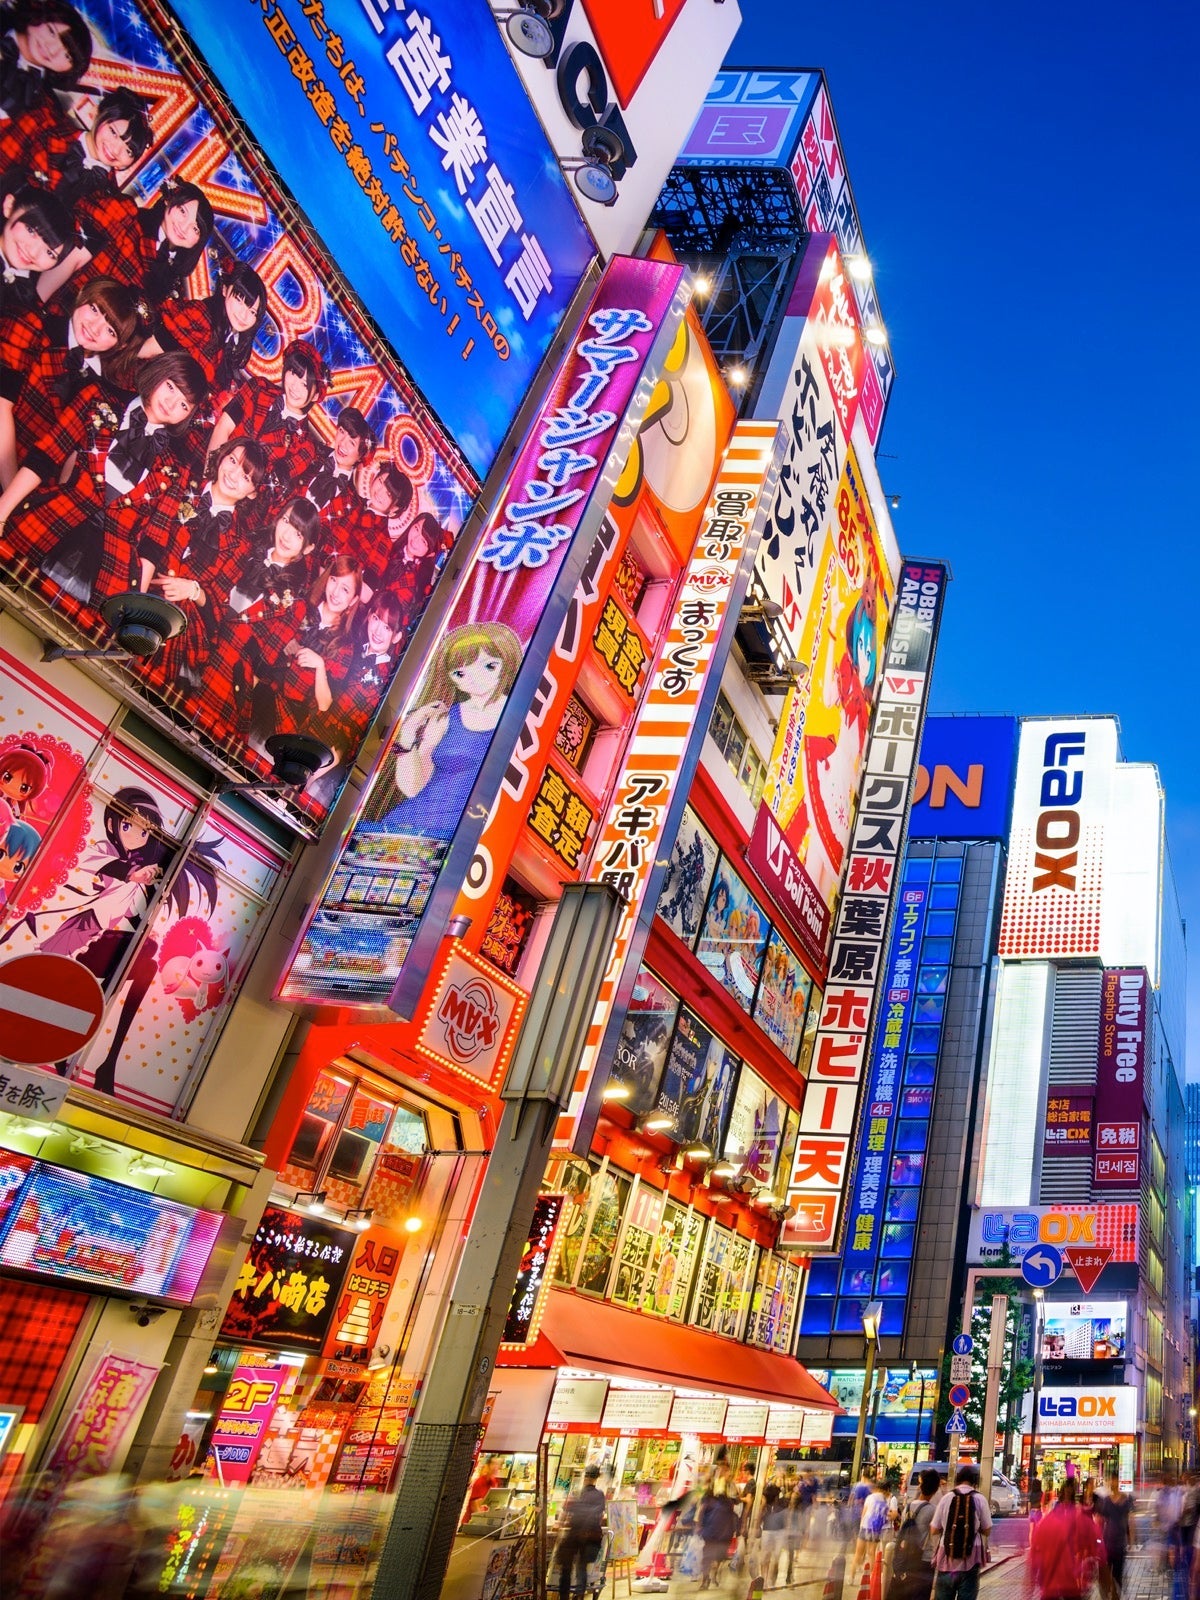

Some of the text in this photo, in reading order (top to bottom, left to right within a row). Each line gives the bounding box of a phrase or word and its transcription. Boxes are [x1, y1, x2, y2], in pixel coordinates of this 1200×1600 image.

[479, 307, 655, 572] サマージャンボ
[702, 489, 754, 561] 買取り
[889, 566, 924, 666] PARADISE
[917, 568, 942, 634] HOBBY
[661, 599, 723, 696] まっくす
[545, 765, 592, 841] 高額
[529, 797, 584, 867] 査定
[905, 892, 923, 902] 6F
[889, 990, 908, 1001] 5F
[1103, 975, 1118, 1057] Flagship Store
[1115, 974, 1143, 1084] Duty Free
[872, 1104, 892, 1116] 4F
[1048, 1099, 1070, 1111] 本店
[1101, 1127, 1136, 1145] 免税
[1097, 1157, 1136, 1175] 면세점
[355, 1240, 400, 1277] 入口
[1073, 1255, 1105, 1267] 止まれ
[348, 1273, 391, 1298] はコチラ
[222, 1379, 277, 1413] 2F
